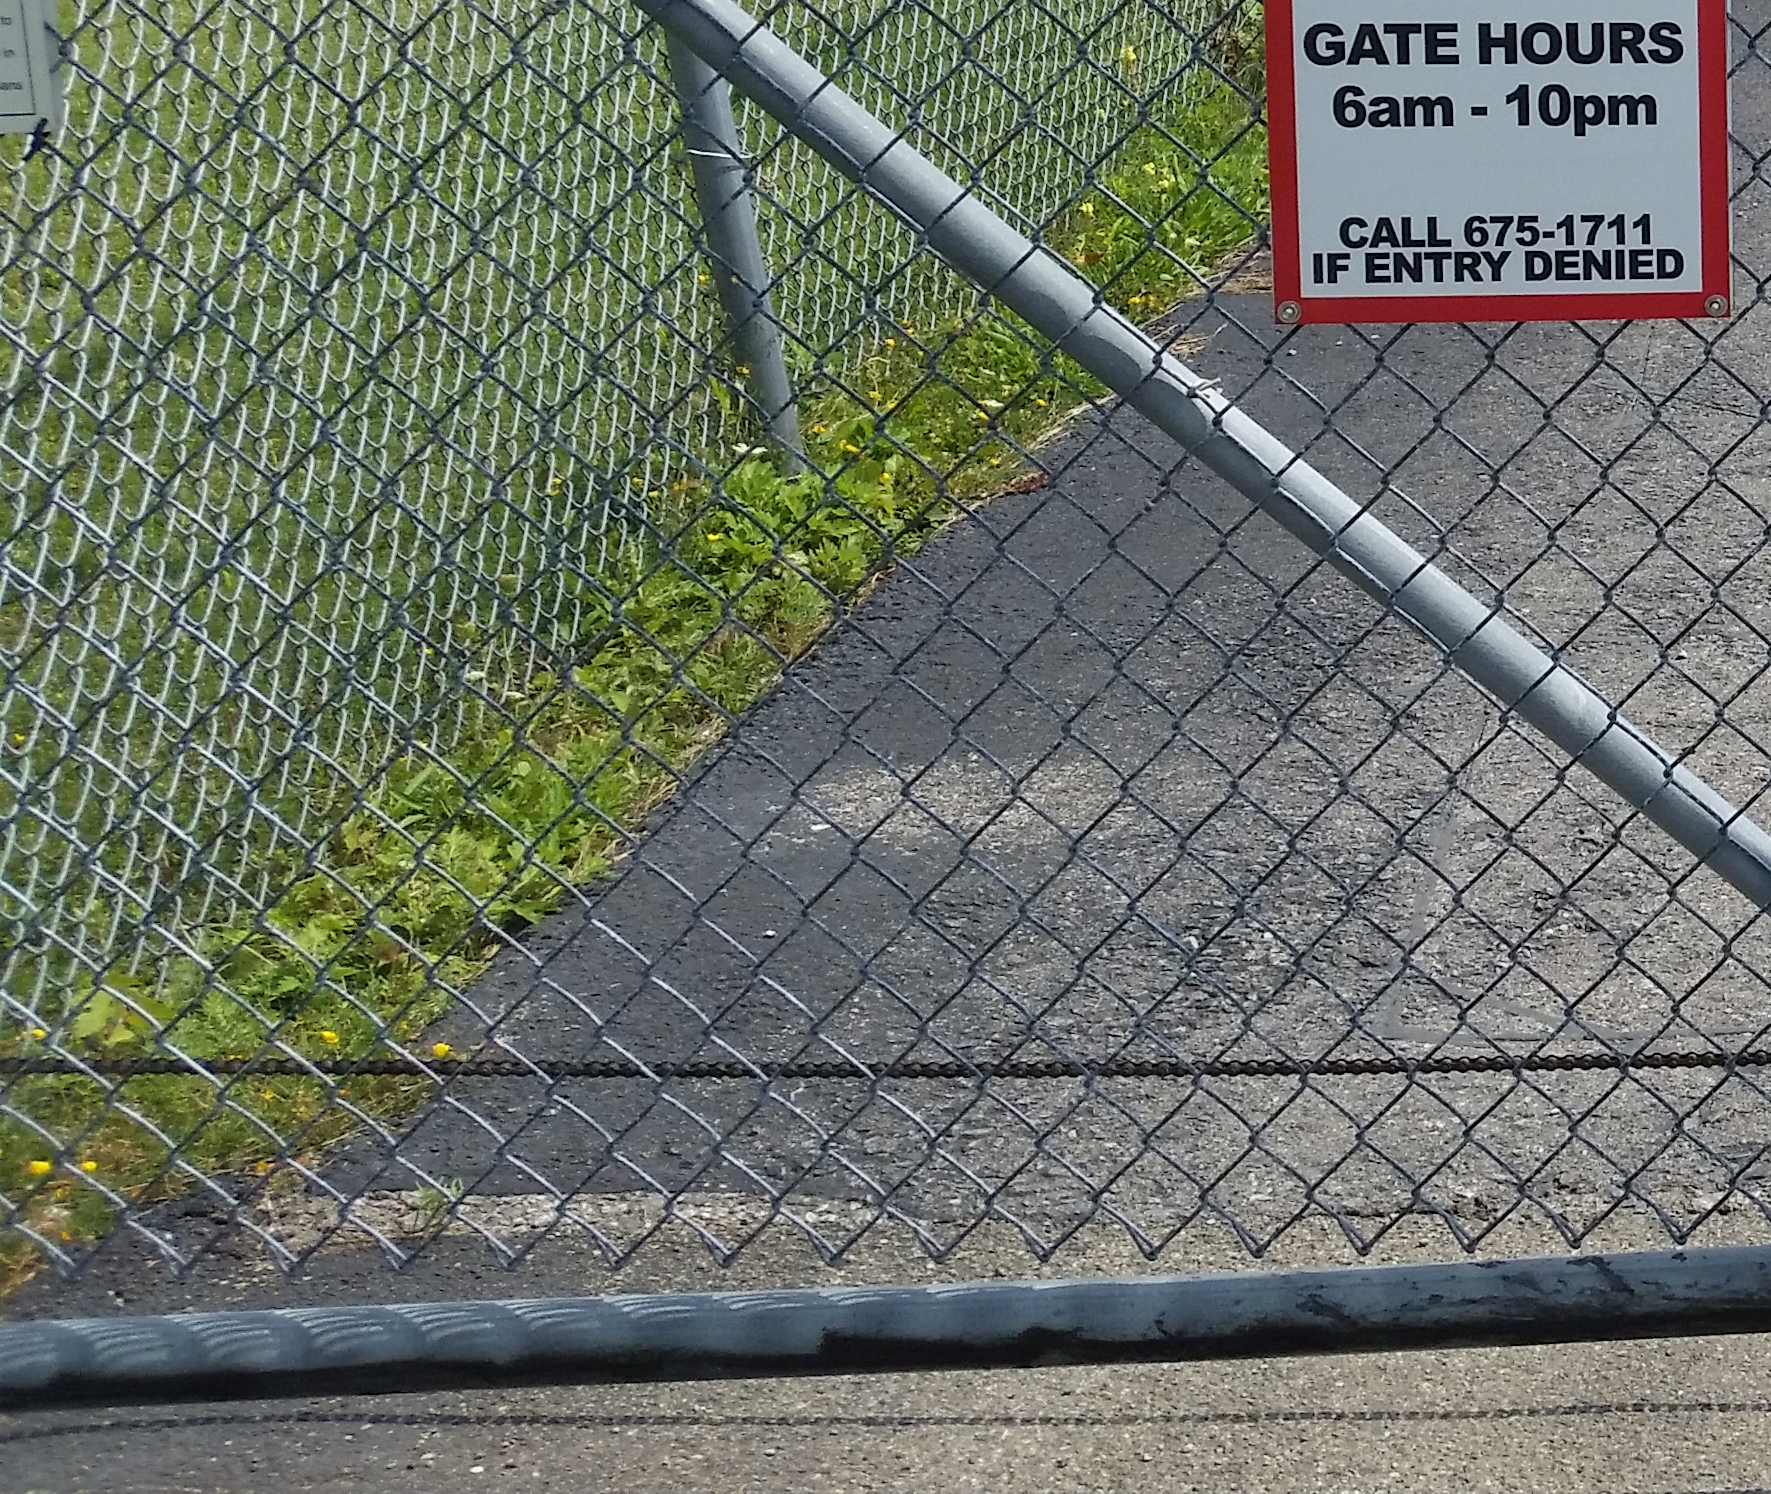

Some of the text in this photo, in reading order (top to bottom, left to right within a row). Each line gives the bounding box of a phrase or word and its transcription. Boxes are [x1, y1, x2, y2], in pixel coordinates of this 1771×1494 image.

[1304, 22, 1683, 65] GATE HOURS
[1333, 86, 1453, 127] 6am
[1506, 84, 1657, 136] 10pm
[1340, 214, 1650, 248] CALL 675-1711
[1313, 249, 1684, 283] IF ENTRY DENIED
